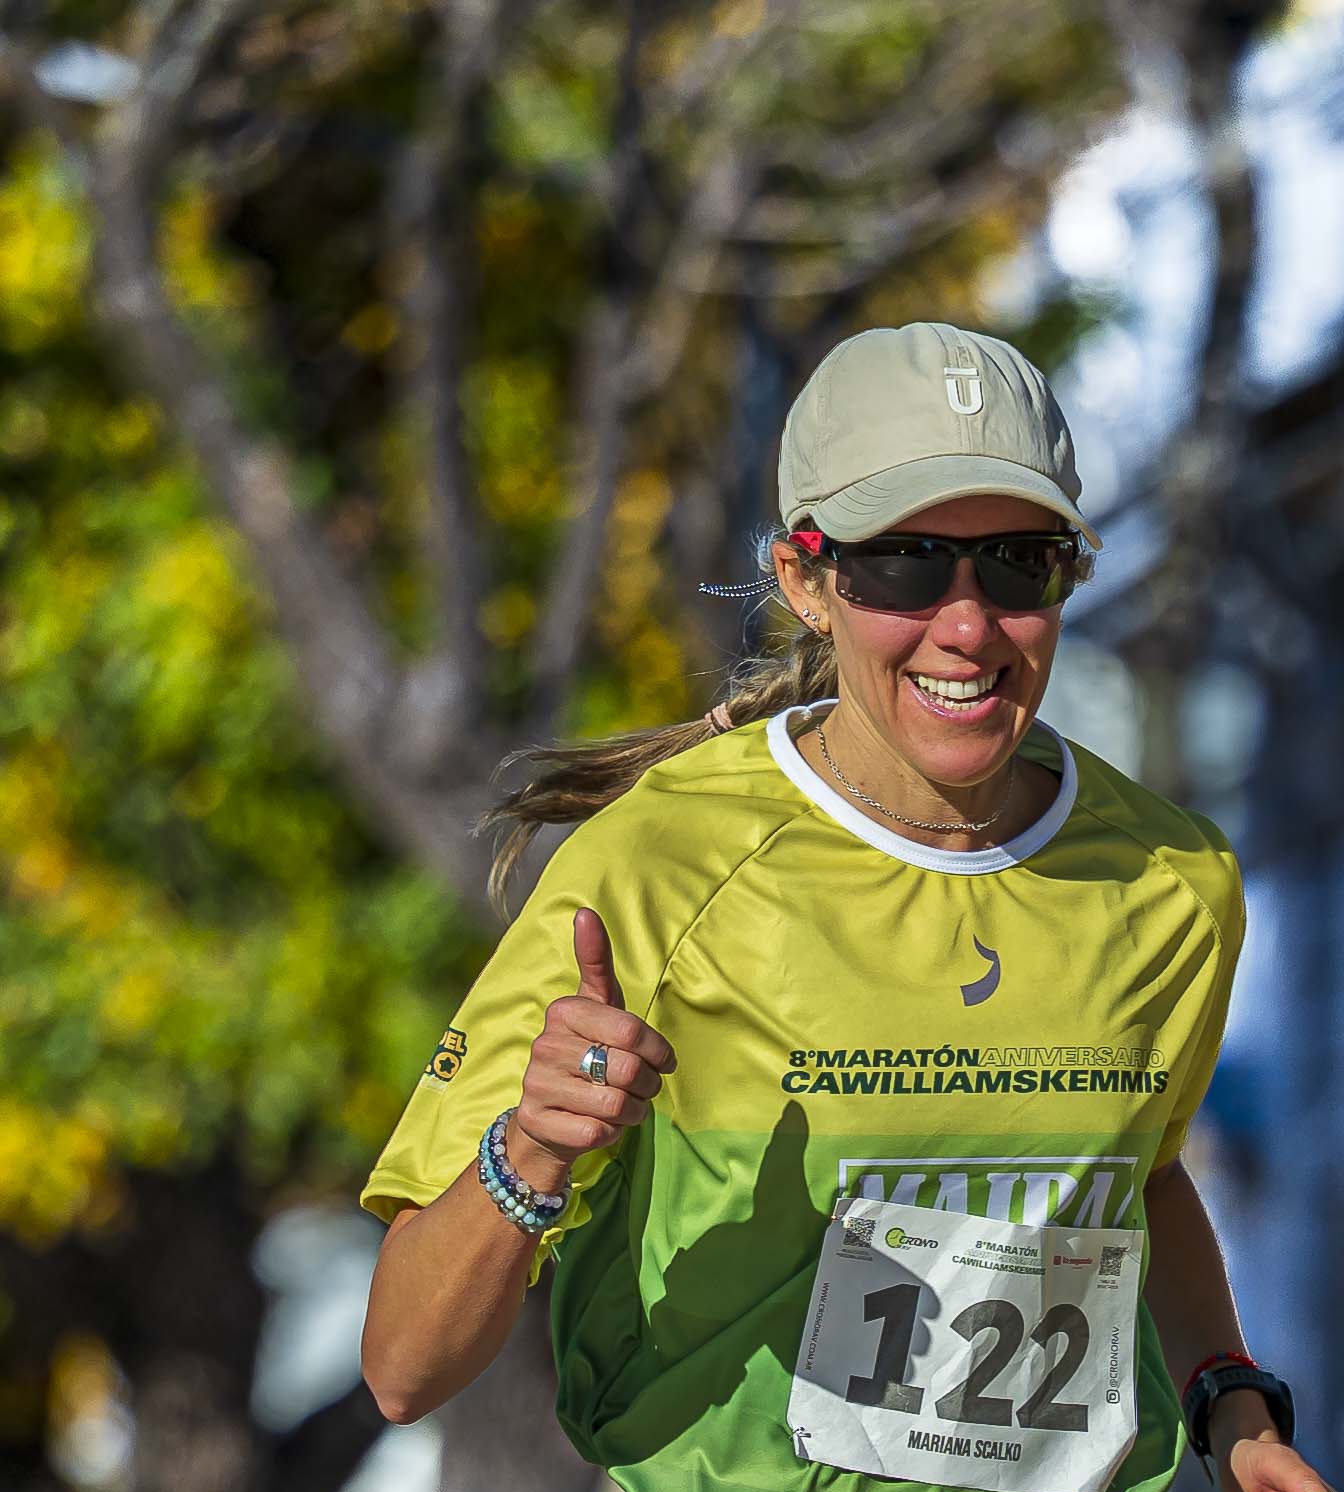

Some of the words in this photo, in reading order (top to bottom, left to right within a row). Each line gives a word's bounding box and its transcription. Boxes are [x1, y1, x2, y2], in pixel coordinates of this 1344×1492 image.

[780, 1069, 1170, 1095] CAWILLIAMSKEMMIS
[845, 1282, 1091, 1433] 122
[907, 1430, 971, 1457] MARIANA
[974, 1440, 1022, 1461] SCALKO
